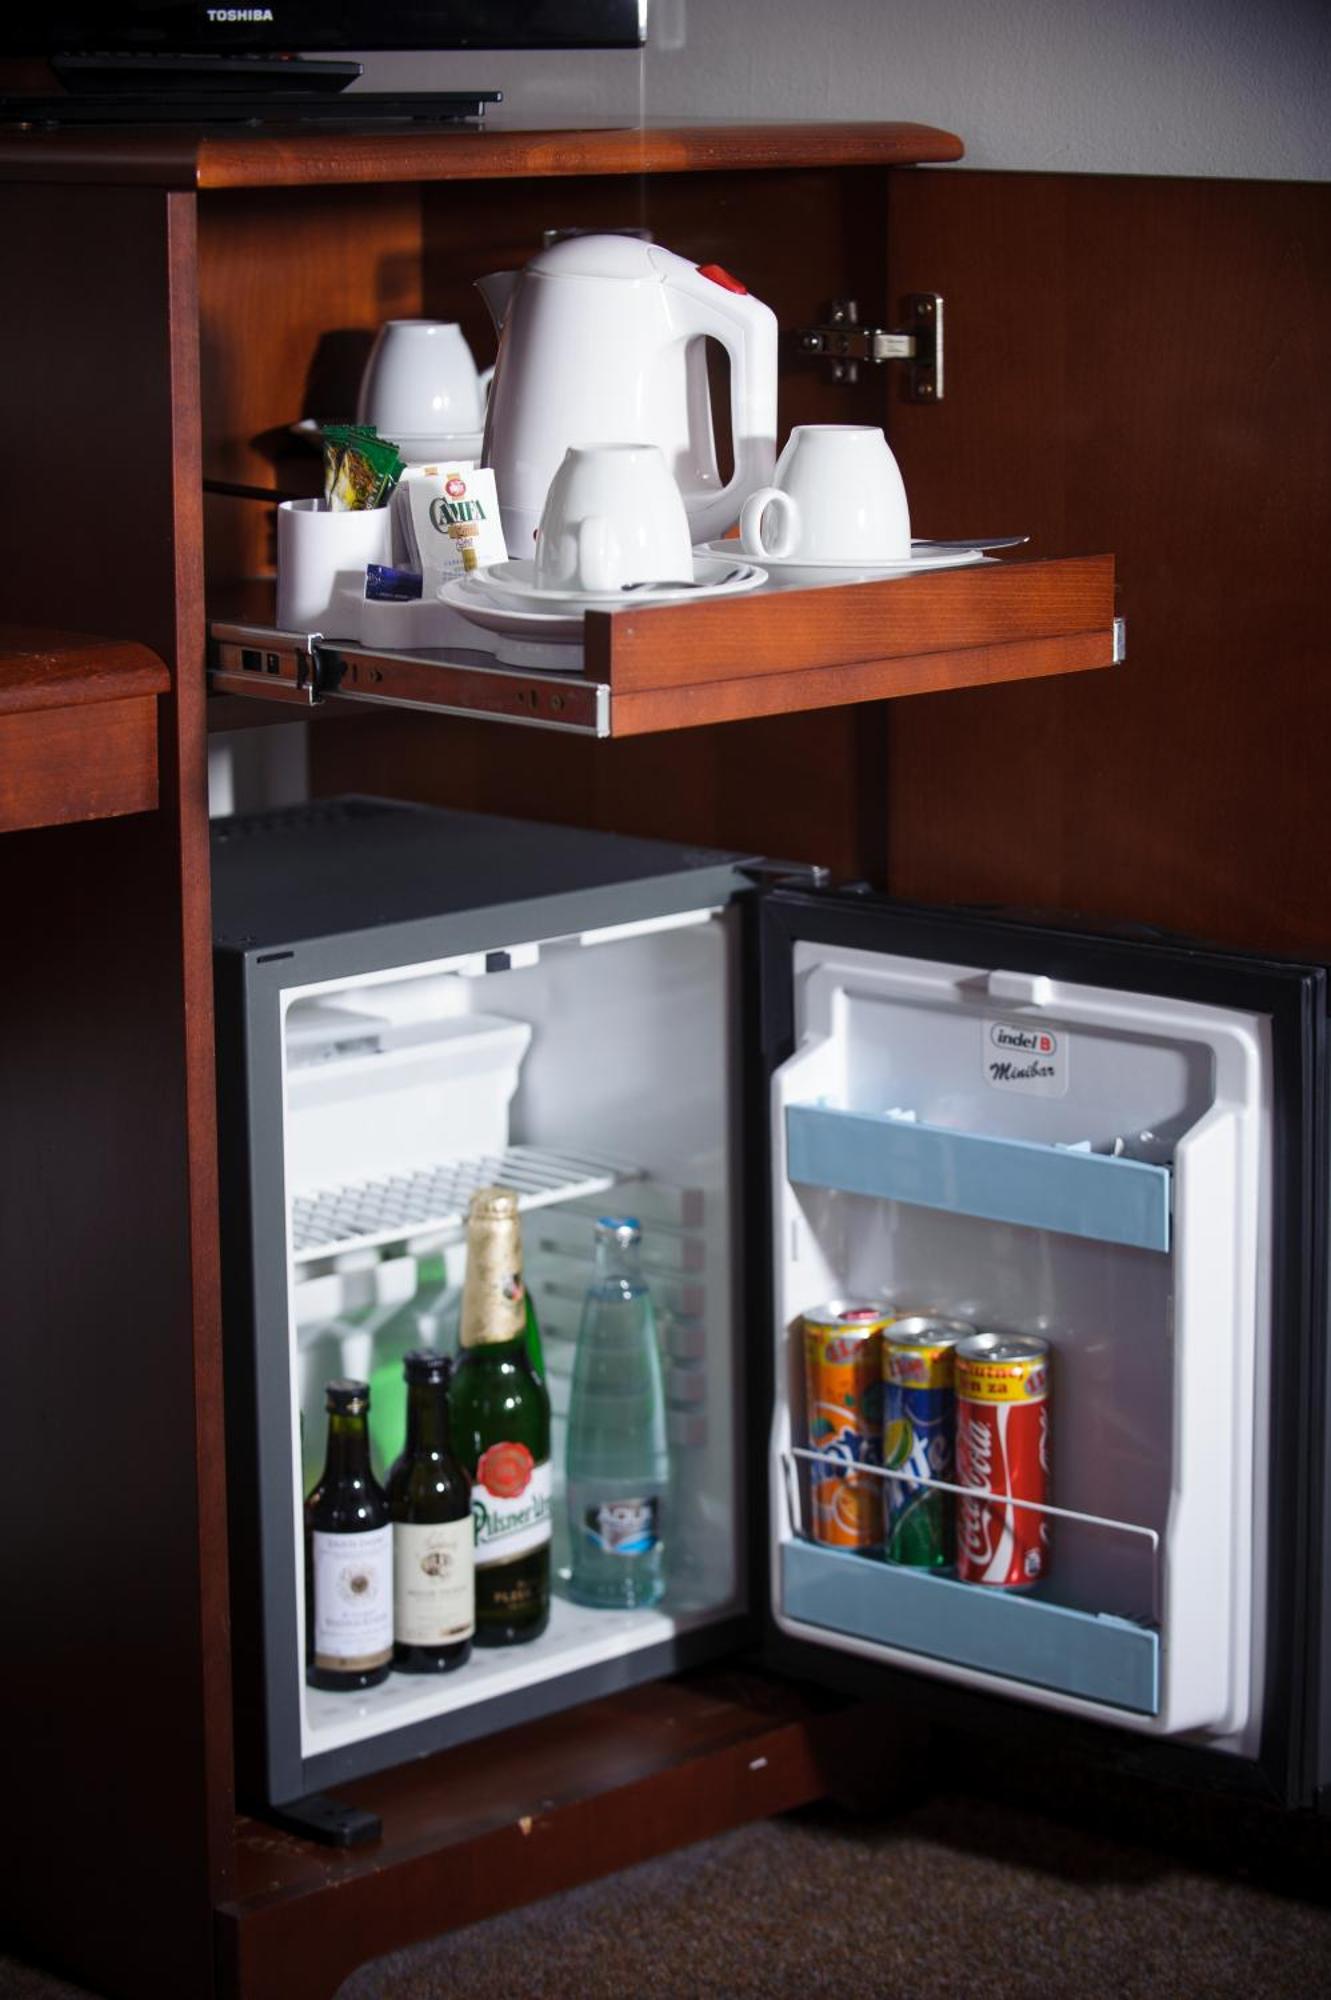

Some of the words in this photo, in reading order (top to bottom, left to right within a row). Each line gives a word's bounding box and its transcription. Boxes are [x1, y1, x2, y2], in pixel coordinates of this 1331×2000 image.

[206, 8, 274, 22] TOSHIBA
[998, 1028, 1037, 1049] indel
[1040, 1035, 1051, 1052] B
[990, 1059, 1054, 1082] Minibar
